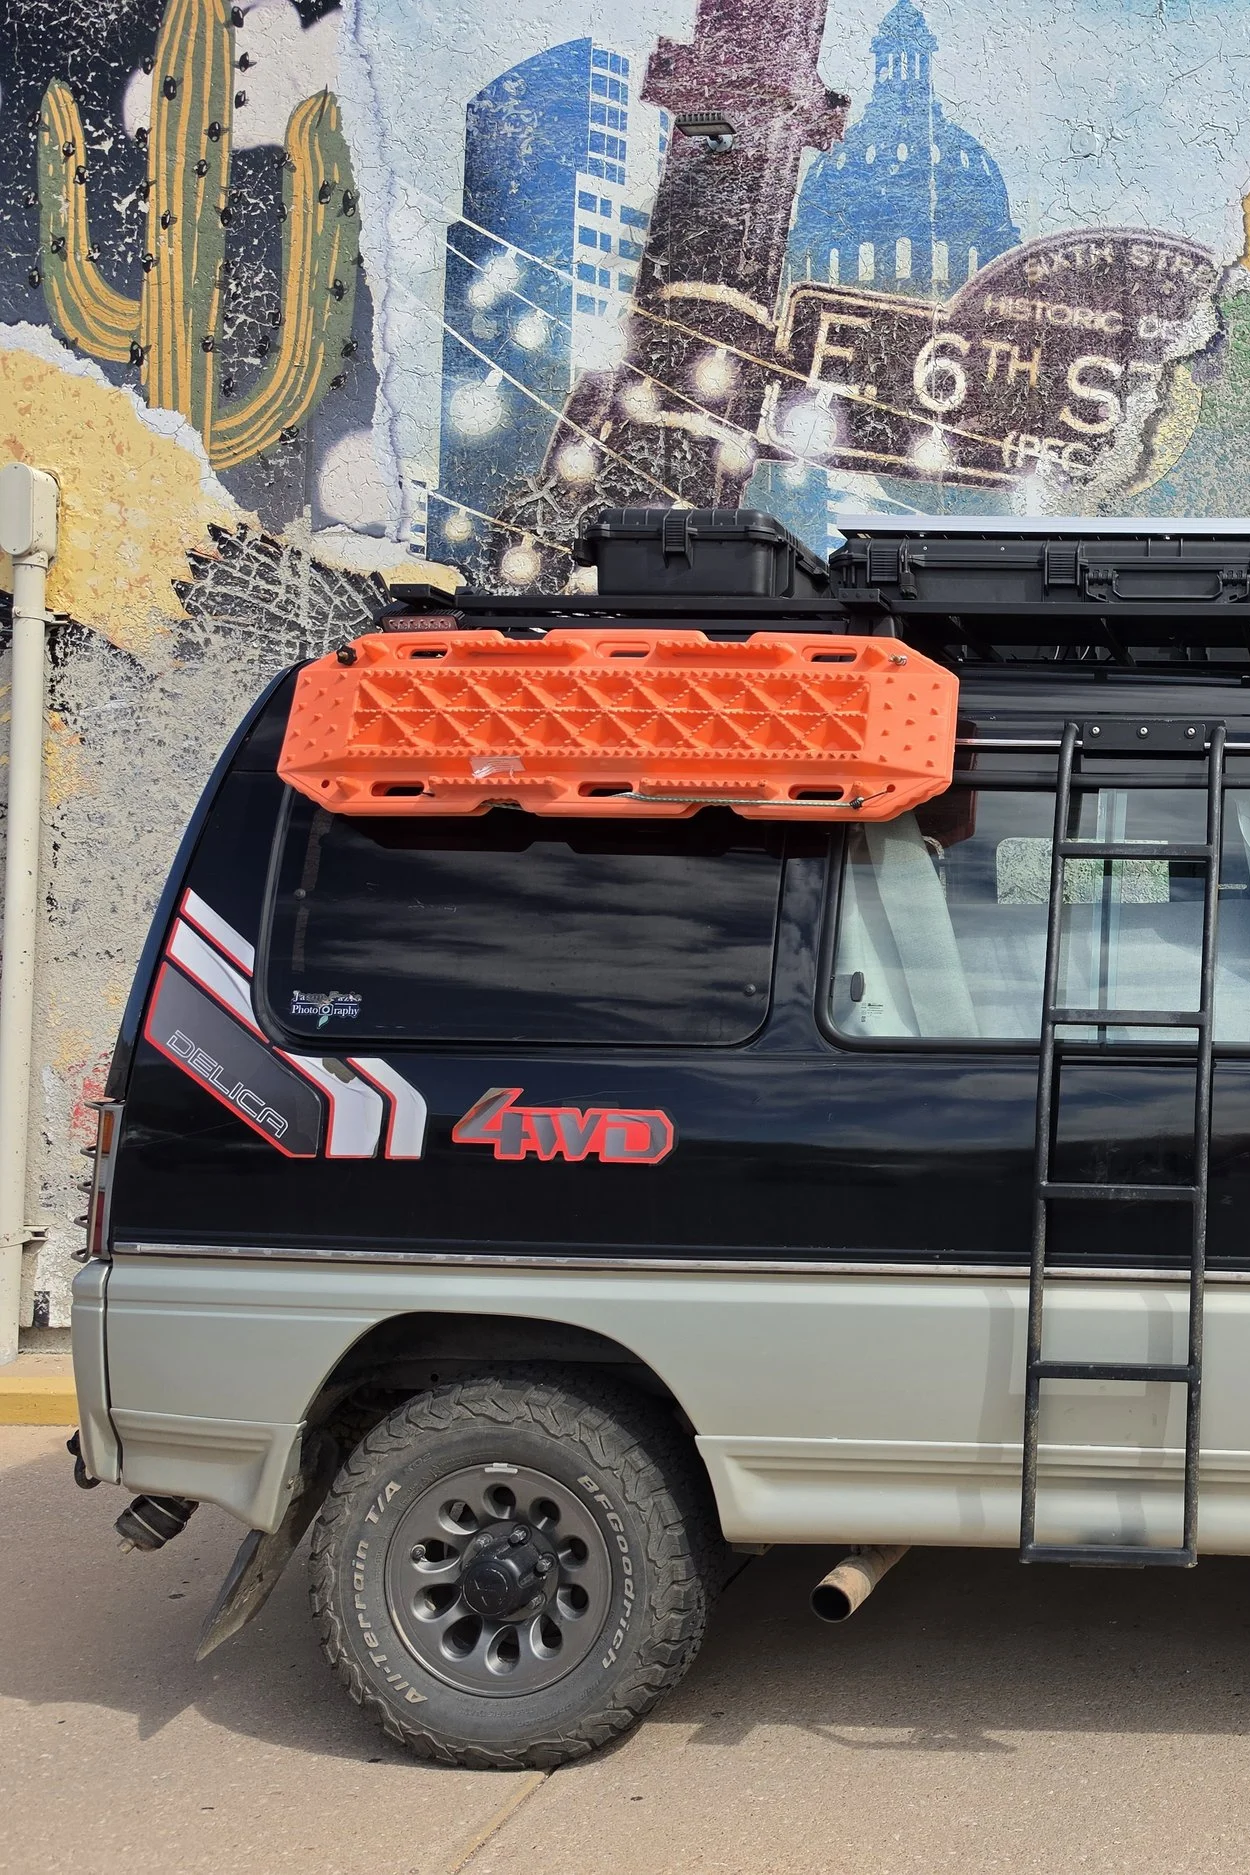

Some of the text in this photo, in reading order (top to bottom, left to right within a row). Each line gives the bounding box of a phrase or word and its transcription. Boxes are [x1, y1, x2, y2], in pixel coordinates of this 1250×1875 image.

[984, 296, 1125, 335] HISTORIC
[291, 1004, 359, 1017] Photoraphy
[165, 1028, 290, 1140] DELICA
[452, 1087, 676, 1164] 4WD
[364, 1480, 402, 1526] T/A
[577, 1475, 636, 1669] BFGoodrich
[352, 1539, 429, 1704] All-Terrain
